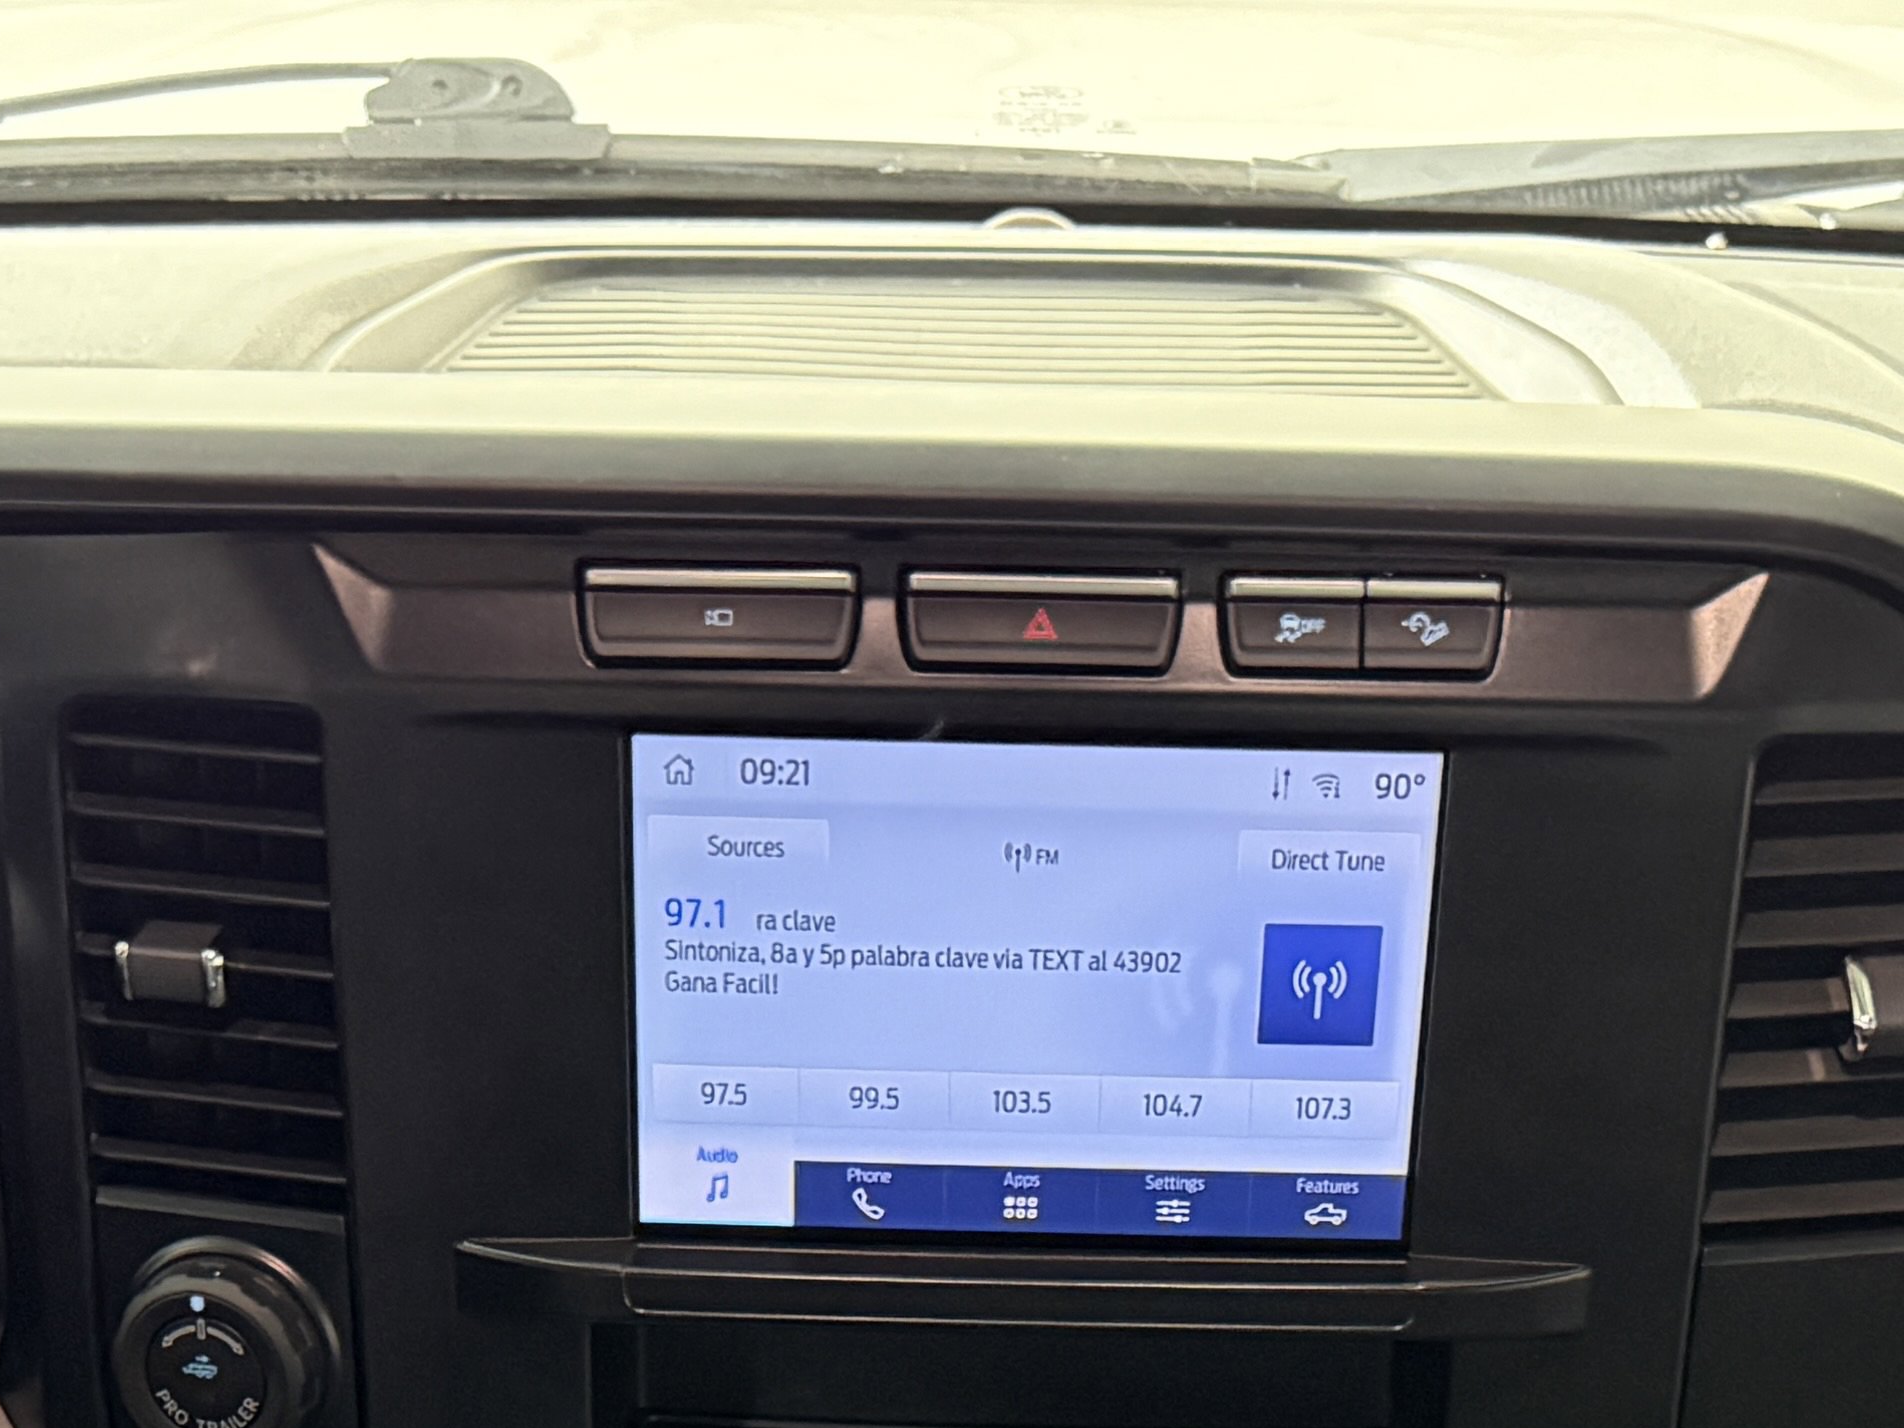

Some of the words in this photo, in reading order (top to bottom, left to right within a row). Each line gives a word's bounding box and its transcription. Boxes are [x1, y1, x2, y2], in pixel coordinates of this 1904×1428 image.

[739, 758, 811, 786] 09:21
[1374, 772, 1426, 800] 90°
[707, 834, 785, 858] Sources
[1035, 848, 1059, 865] FM
[1271, 848, 1329, 871] Direct
[1335, 850, 1385, 872] Tune
[664, 898, 727, 929] 97.1
[756, 913, 777, 932] ra
[781, 910, 836, 932] clave
[664, 939, 766, 966] Sintoniza,
[770, 942, 797, 964] 8a
[802, 948, 814, 968] y
[819, 944, 846, 969] 5p
[850, 943, 930, 971] palabra
[934, 945, 988, 969] clave
[993, 947, 1023, 970] via
[1029, 950, 1084, 971] TEXT
[1088, 951, 1108, 972] al
[1113, 951, 1182, 973] 43902
[664, 971, 718, 994] Gana
[723, 971, 779, 995] Facil!
[700, 1082, 748, 1106] 97.5
[849, 1086, 900, 1110] 99.5
[993, 1090, 1051, 1114] 103.5
[1143, 1093, 1202, 1118] 104.7
[1295, 1097, 1352, 1120] 107.3
[697, 1146, 738, 1163] Audio
[847, 1167, 892, 1185] Phone
[1004, 1171, 1041, 1189] Apps
[1145, 1174, 1205, 1193] Settings
[1296, 1178, 1359, 1195] Features
[155, 1388, 189, 1426] PRO
